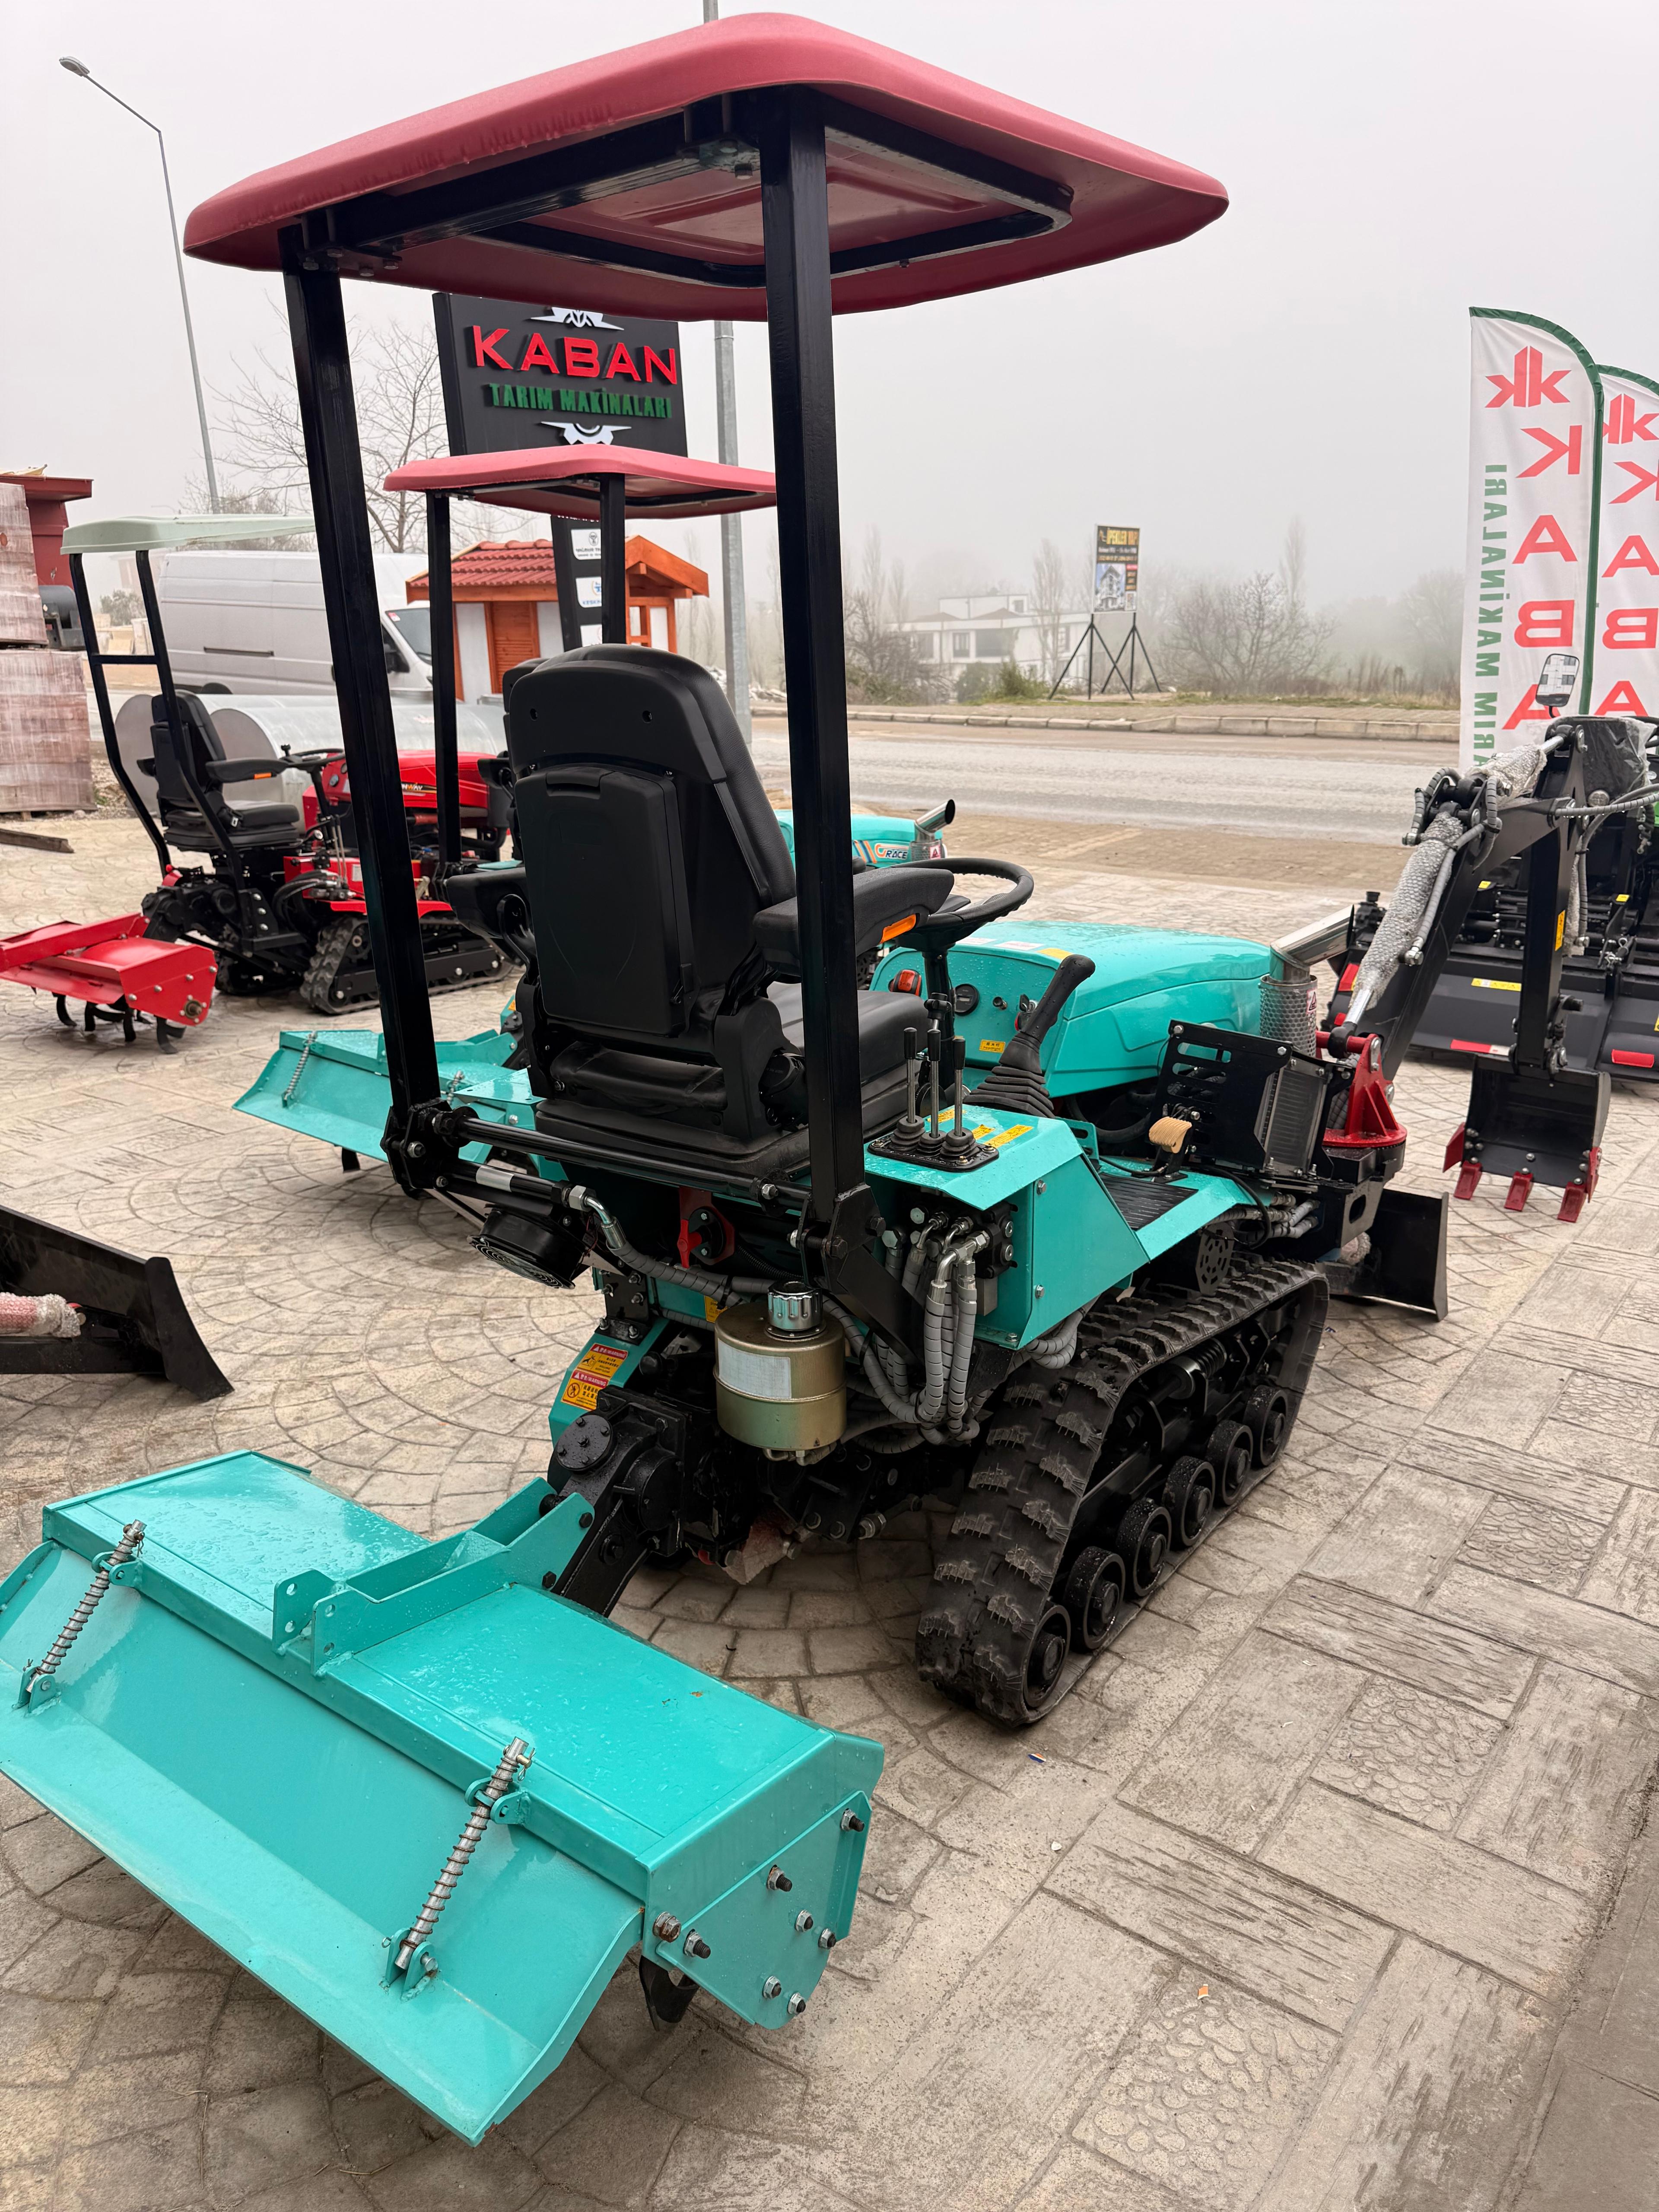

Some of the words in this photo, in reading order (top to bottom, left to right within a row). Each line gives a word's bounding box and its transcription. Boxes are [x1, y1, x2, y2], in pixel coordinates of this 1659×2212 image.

[473, 325, 677, 384] KABAN
[489, 383, 553, 410] TARIM
[560, 388, 672, 418] MAKİNALARI
